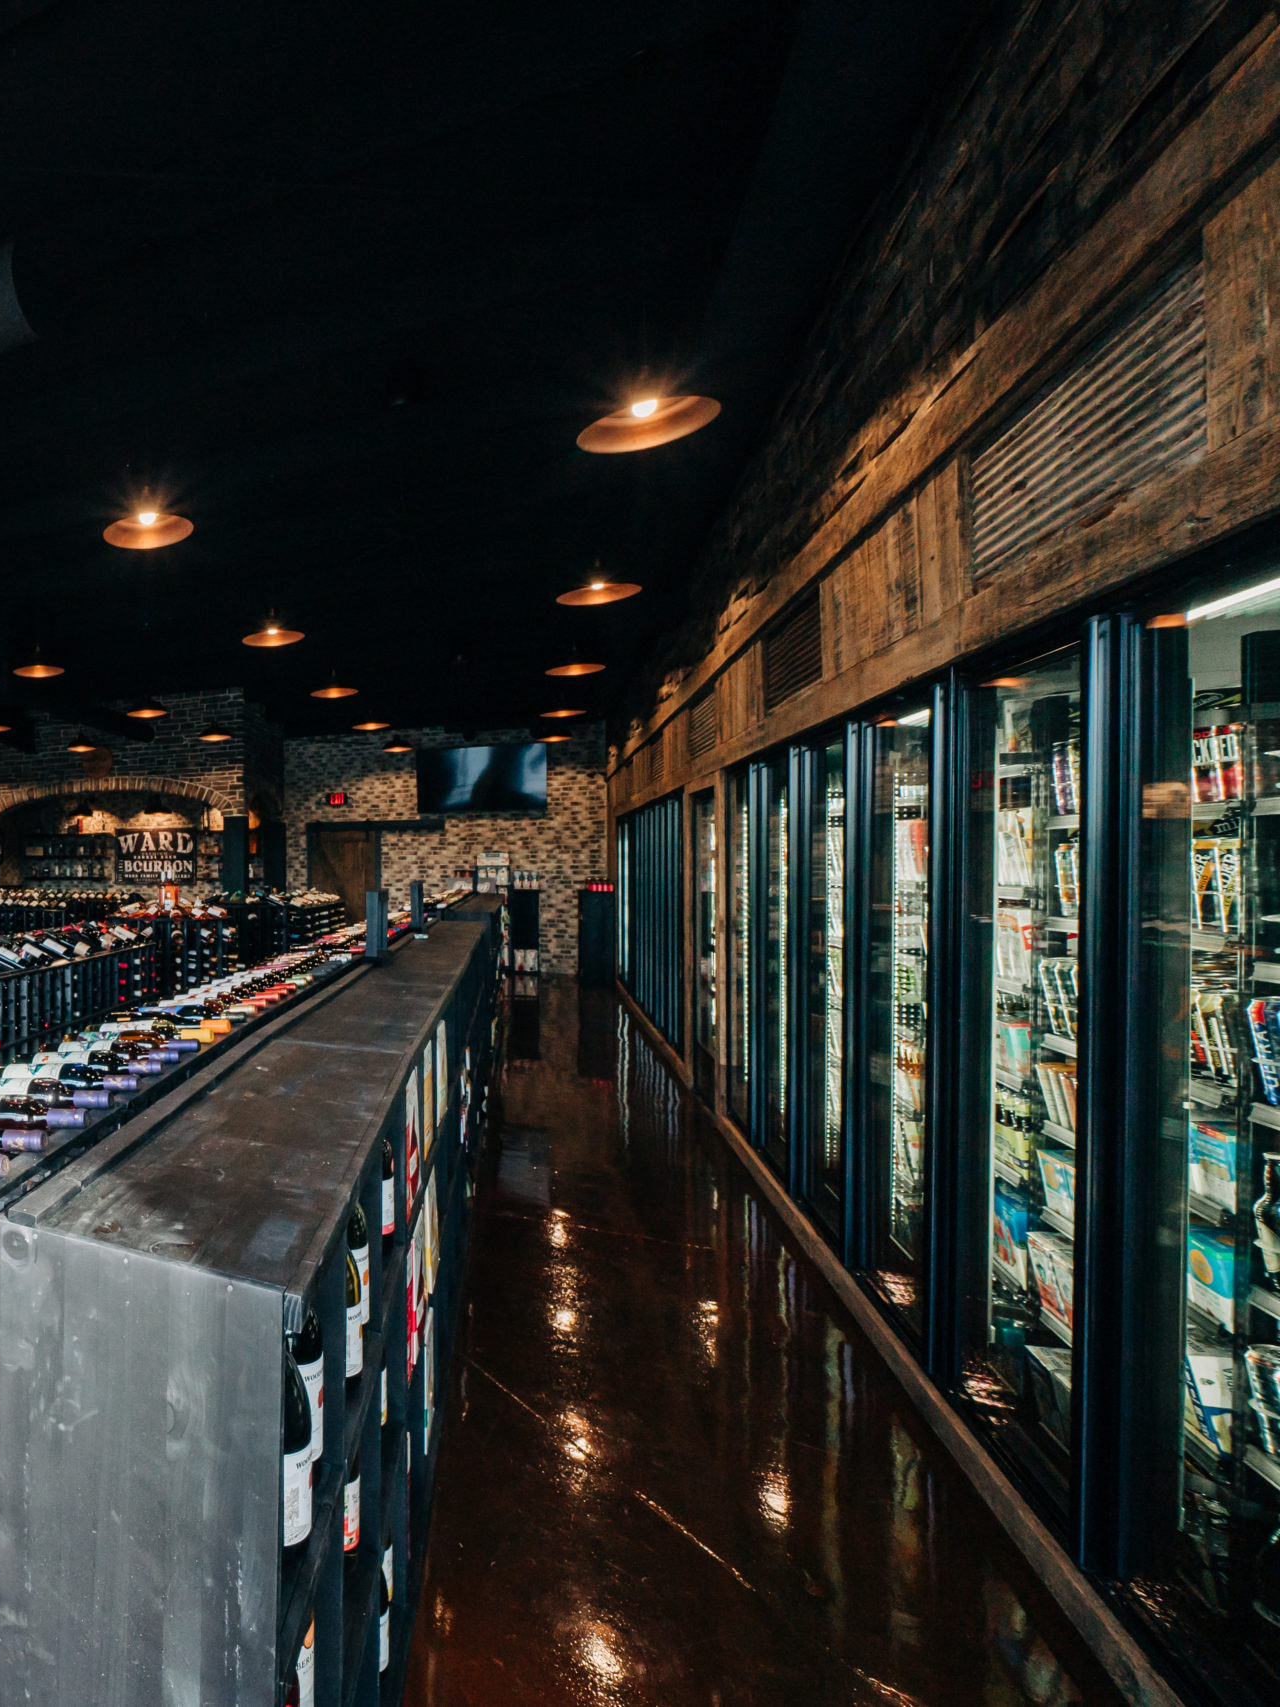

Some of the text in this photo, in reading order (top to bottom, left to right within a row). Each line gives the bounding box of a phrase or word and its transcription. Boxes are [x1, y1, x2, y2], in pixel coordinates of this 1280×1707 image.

[330, 793, 344, 805] EXIT
[118, 831, 194, 855] WARD
[124, 860, 193, 873] BOURBON
